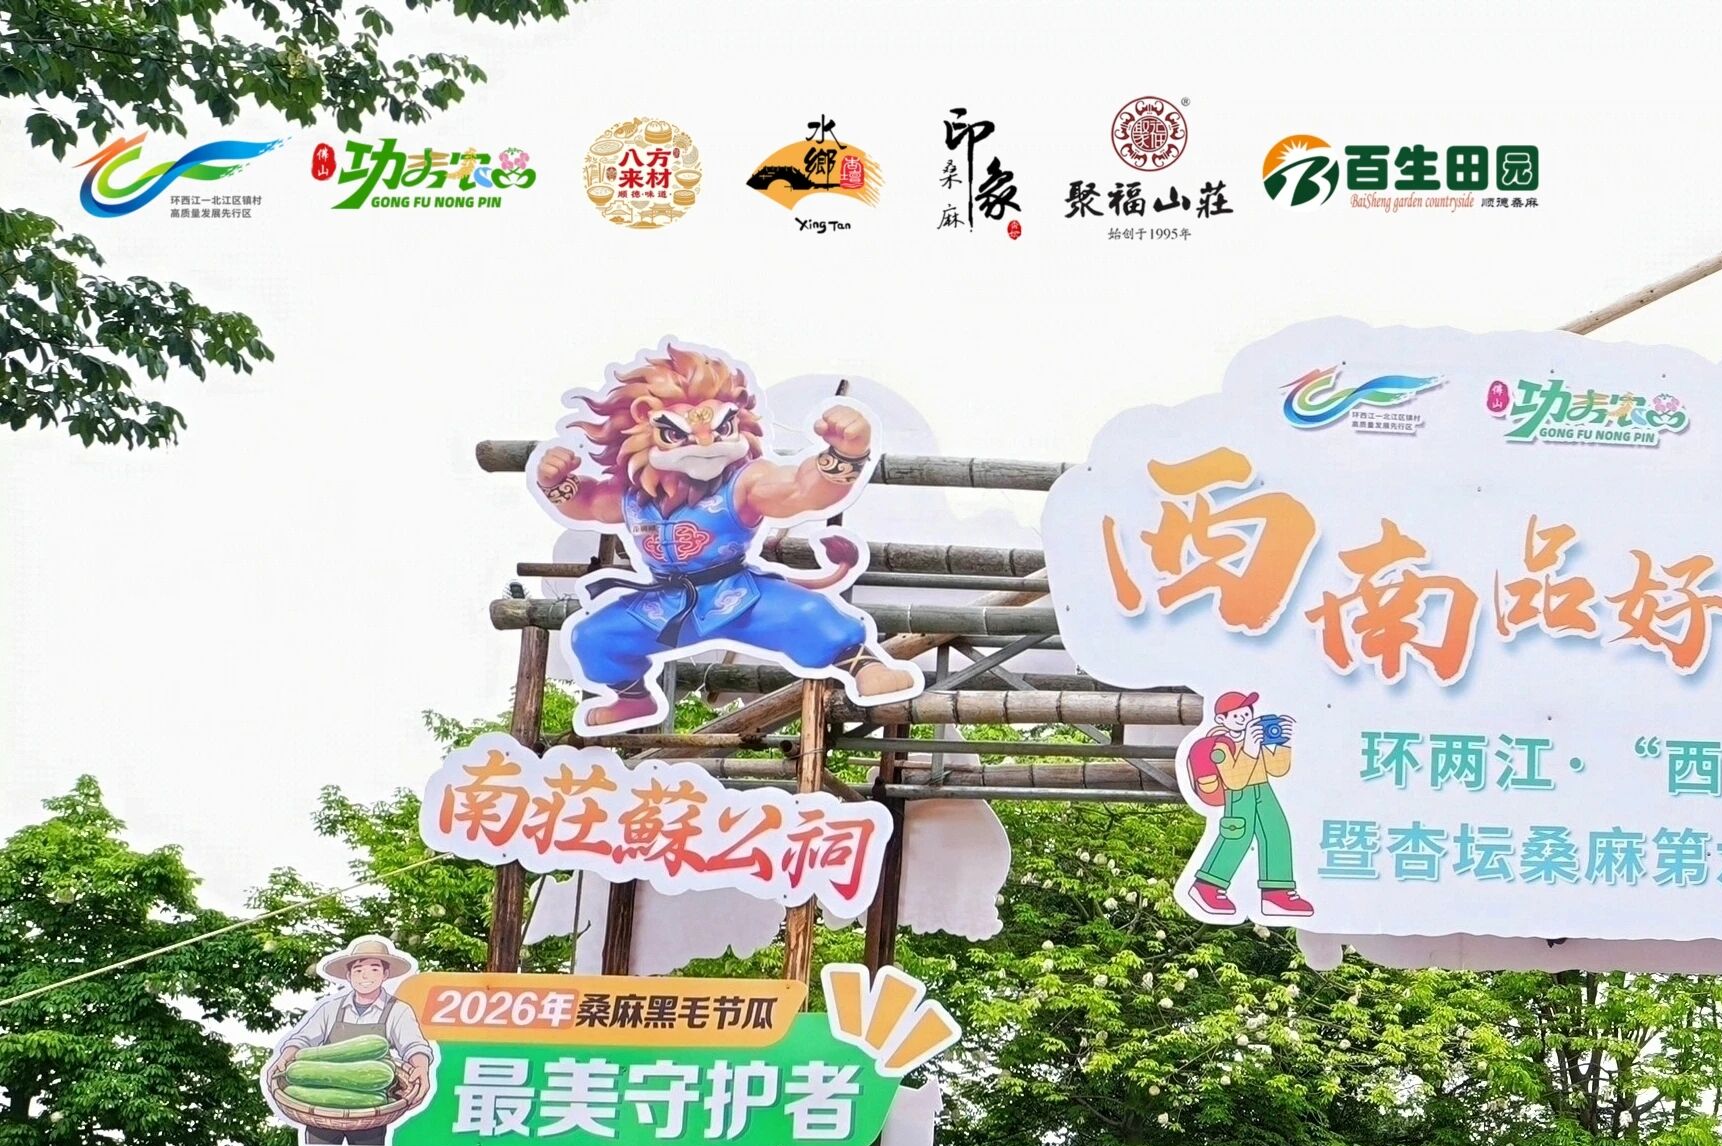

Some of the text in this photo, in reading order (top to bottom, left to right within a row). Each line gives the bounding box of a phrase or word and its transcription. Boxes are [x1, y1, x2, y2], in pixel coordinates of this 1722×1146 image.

[1539, 427, 1655, 443] GONG FU NONG PIN
[451, 1055, 863, 1141] 最美守护者
